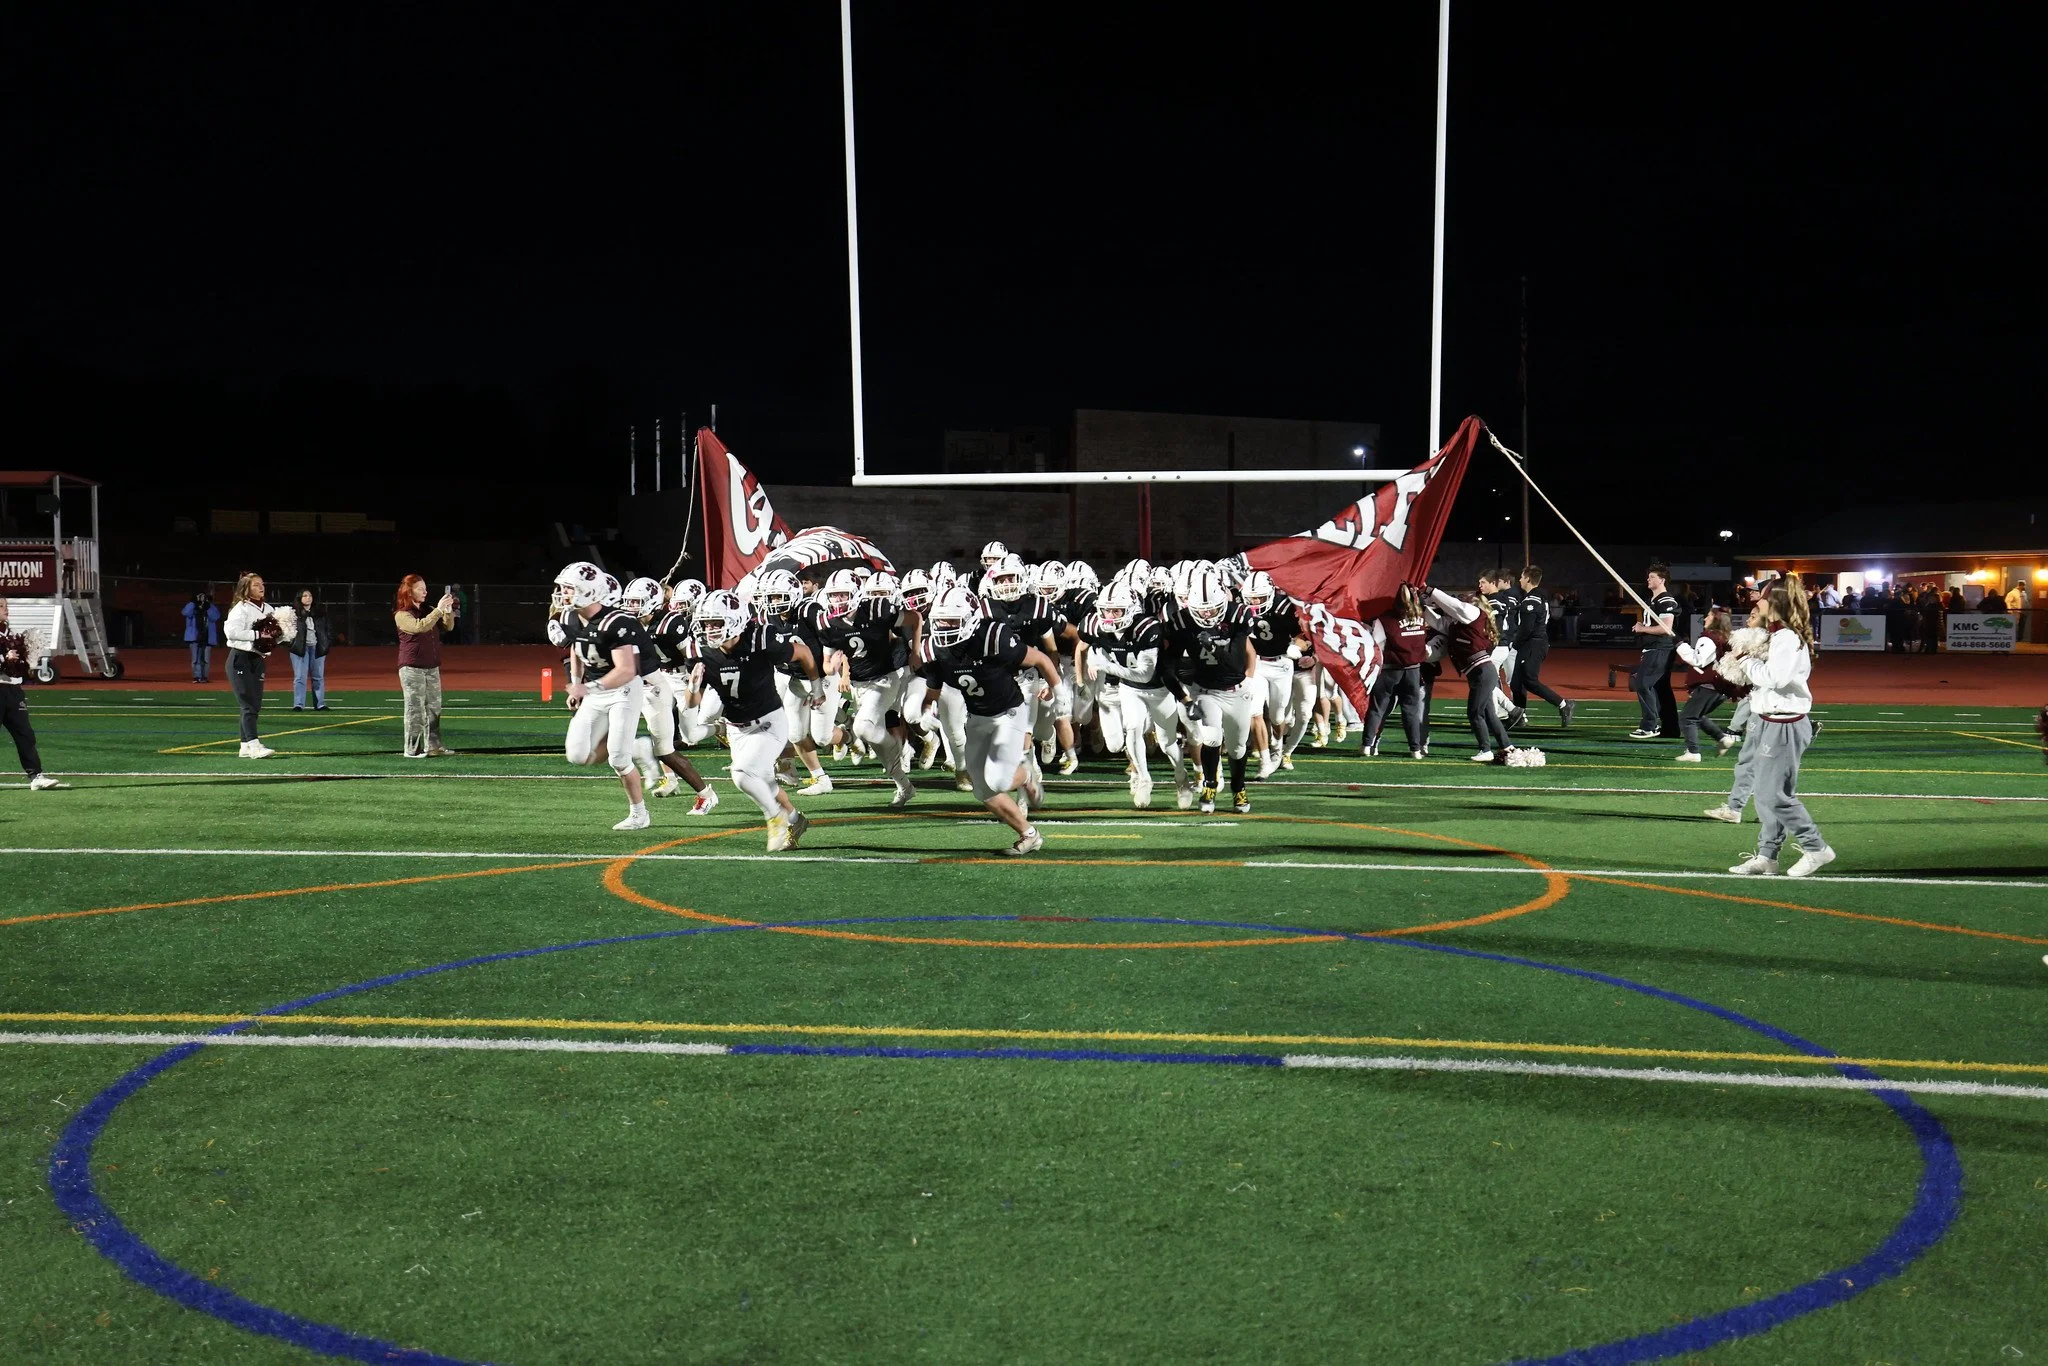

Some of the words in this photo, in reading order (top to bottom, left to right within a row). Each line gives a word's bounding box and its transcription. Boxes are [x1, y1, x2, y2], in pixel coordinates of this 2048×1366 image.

[0, 561, 43, 578] ATION!
[7, 579, 30, 587] 2015
[1257, 620, 1273, 640] 3
[1953, 623, 1979, 631] KMC
[574, 641, 610, 668] 14
[849, 636, 868, 658] 2
[720, 671, 740, 698] 7
[958, 674, 985, 697] 2
